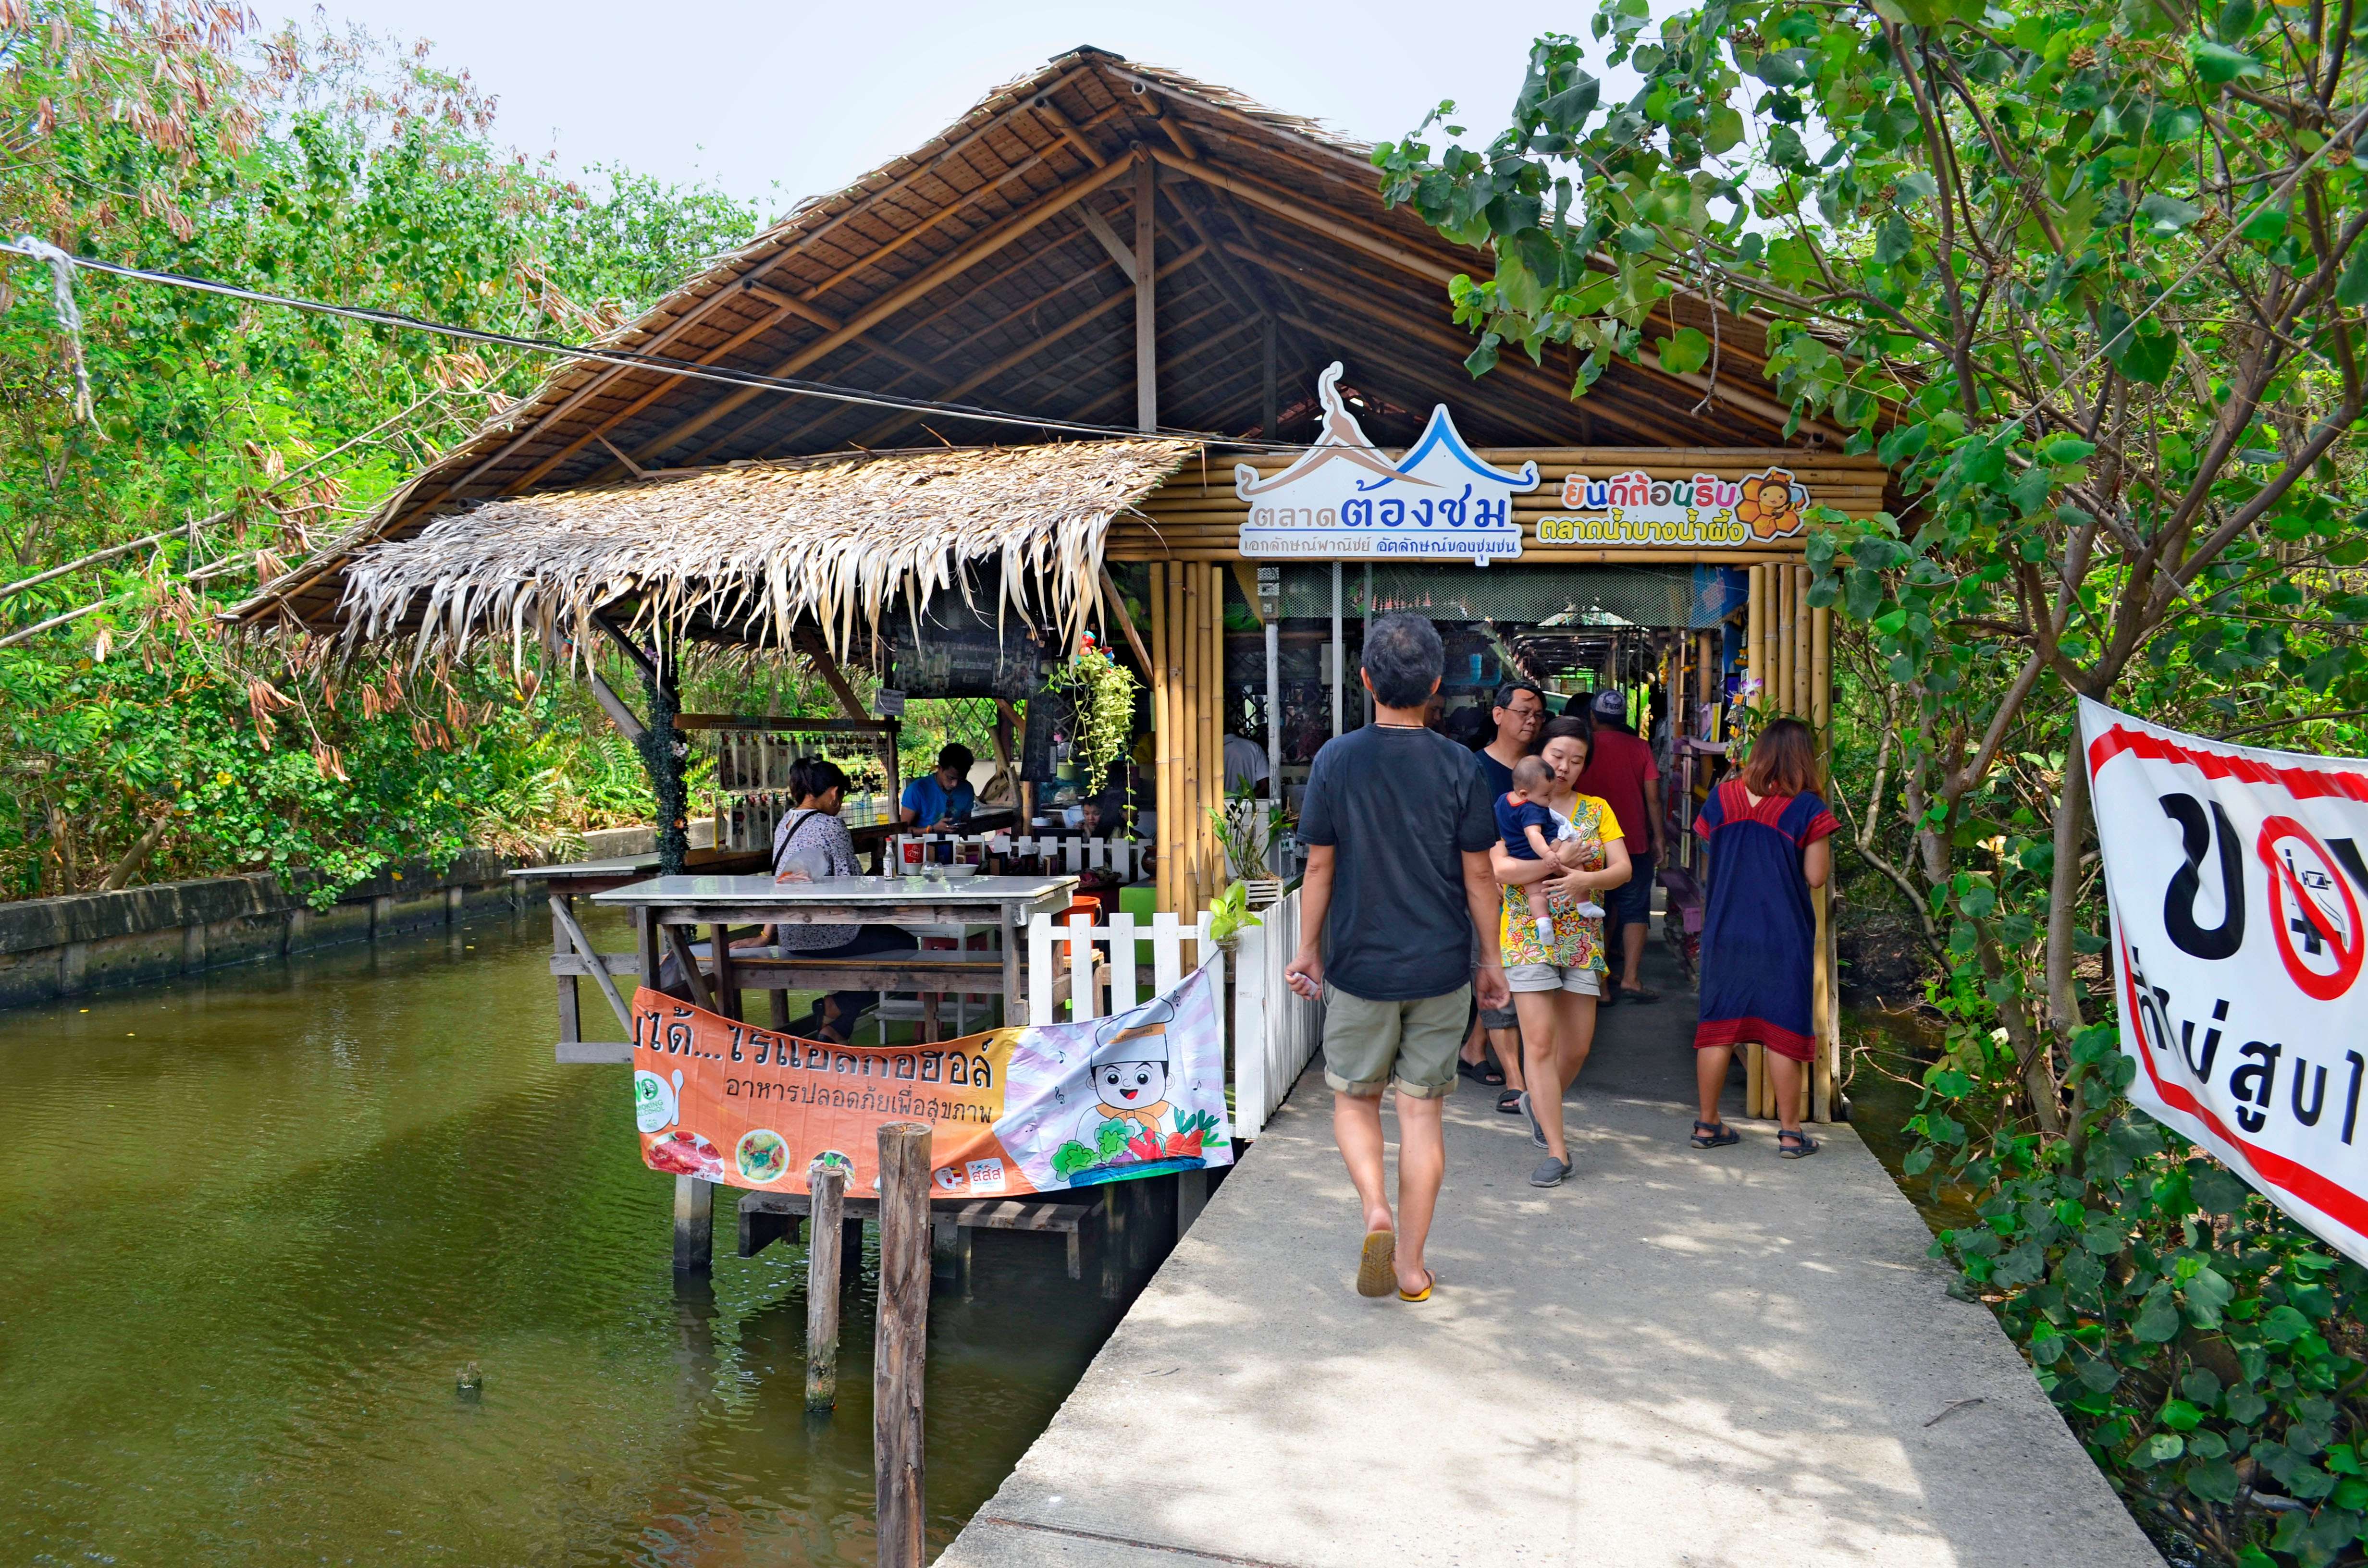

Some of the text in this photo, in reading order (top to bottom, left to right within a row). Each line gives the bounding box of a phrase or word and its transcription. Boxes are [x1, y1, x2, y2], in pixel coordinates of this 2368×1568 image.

[1254, 479, 1506, 527] ตลาด ต้องชม
[1565, 474, 1736, 507] ยินดีต้อนรับ
[1540, 508, 1745, 542] ตลาดน้ำบางน้ำผึ้ง
[1377, 537, 1516, 562] อัตลักษณ์ของชุมชน
[726, 1078, 992, 1125] อาหารปลอดภัยเพื่อสุขภาพ
[972, 1168, 1001, 1182] สสส
